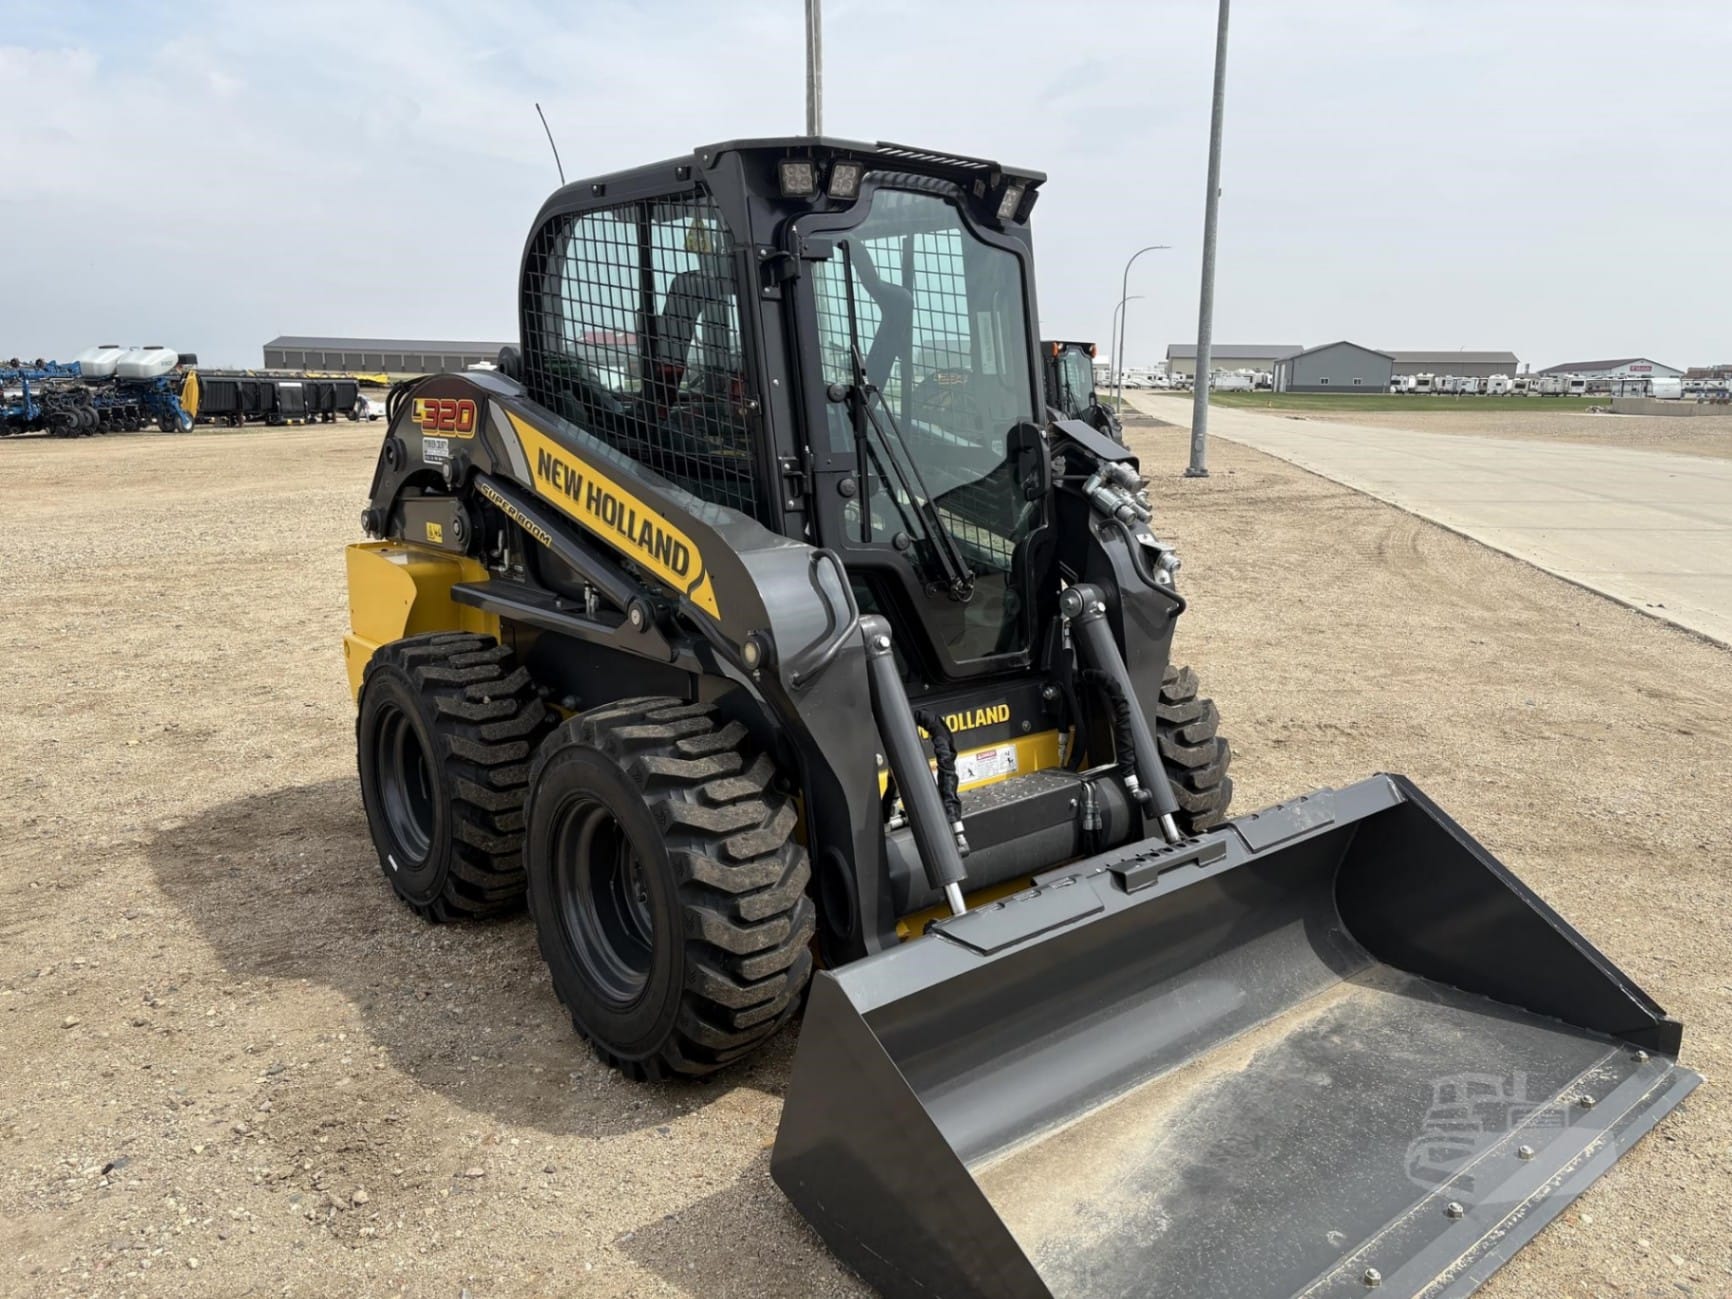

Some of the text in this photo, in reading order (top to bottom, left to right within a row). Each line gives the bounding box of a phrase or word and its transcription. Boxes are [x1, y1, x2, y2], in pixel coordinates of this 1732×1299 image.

[411, 398, 477, 438] L320
[537, 447, 690, 577] NEW HOLLAND
[942, 704, 1010, 733] OLLAND
